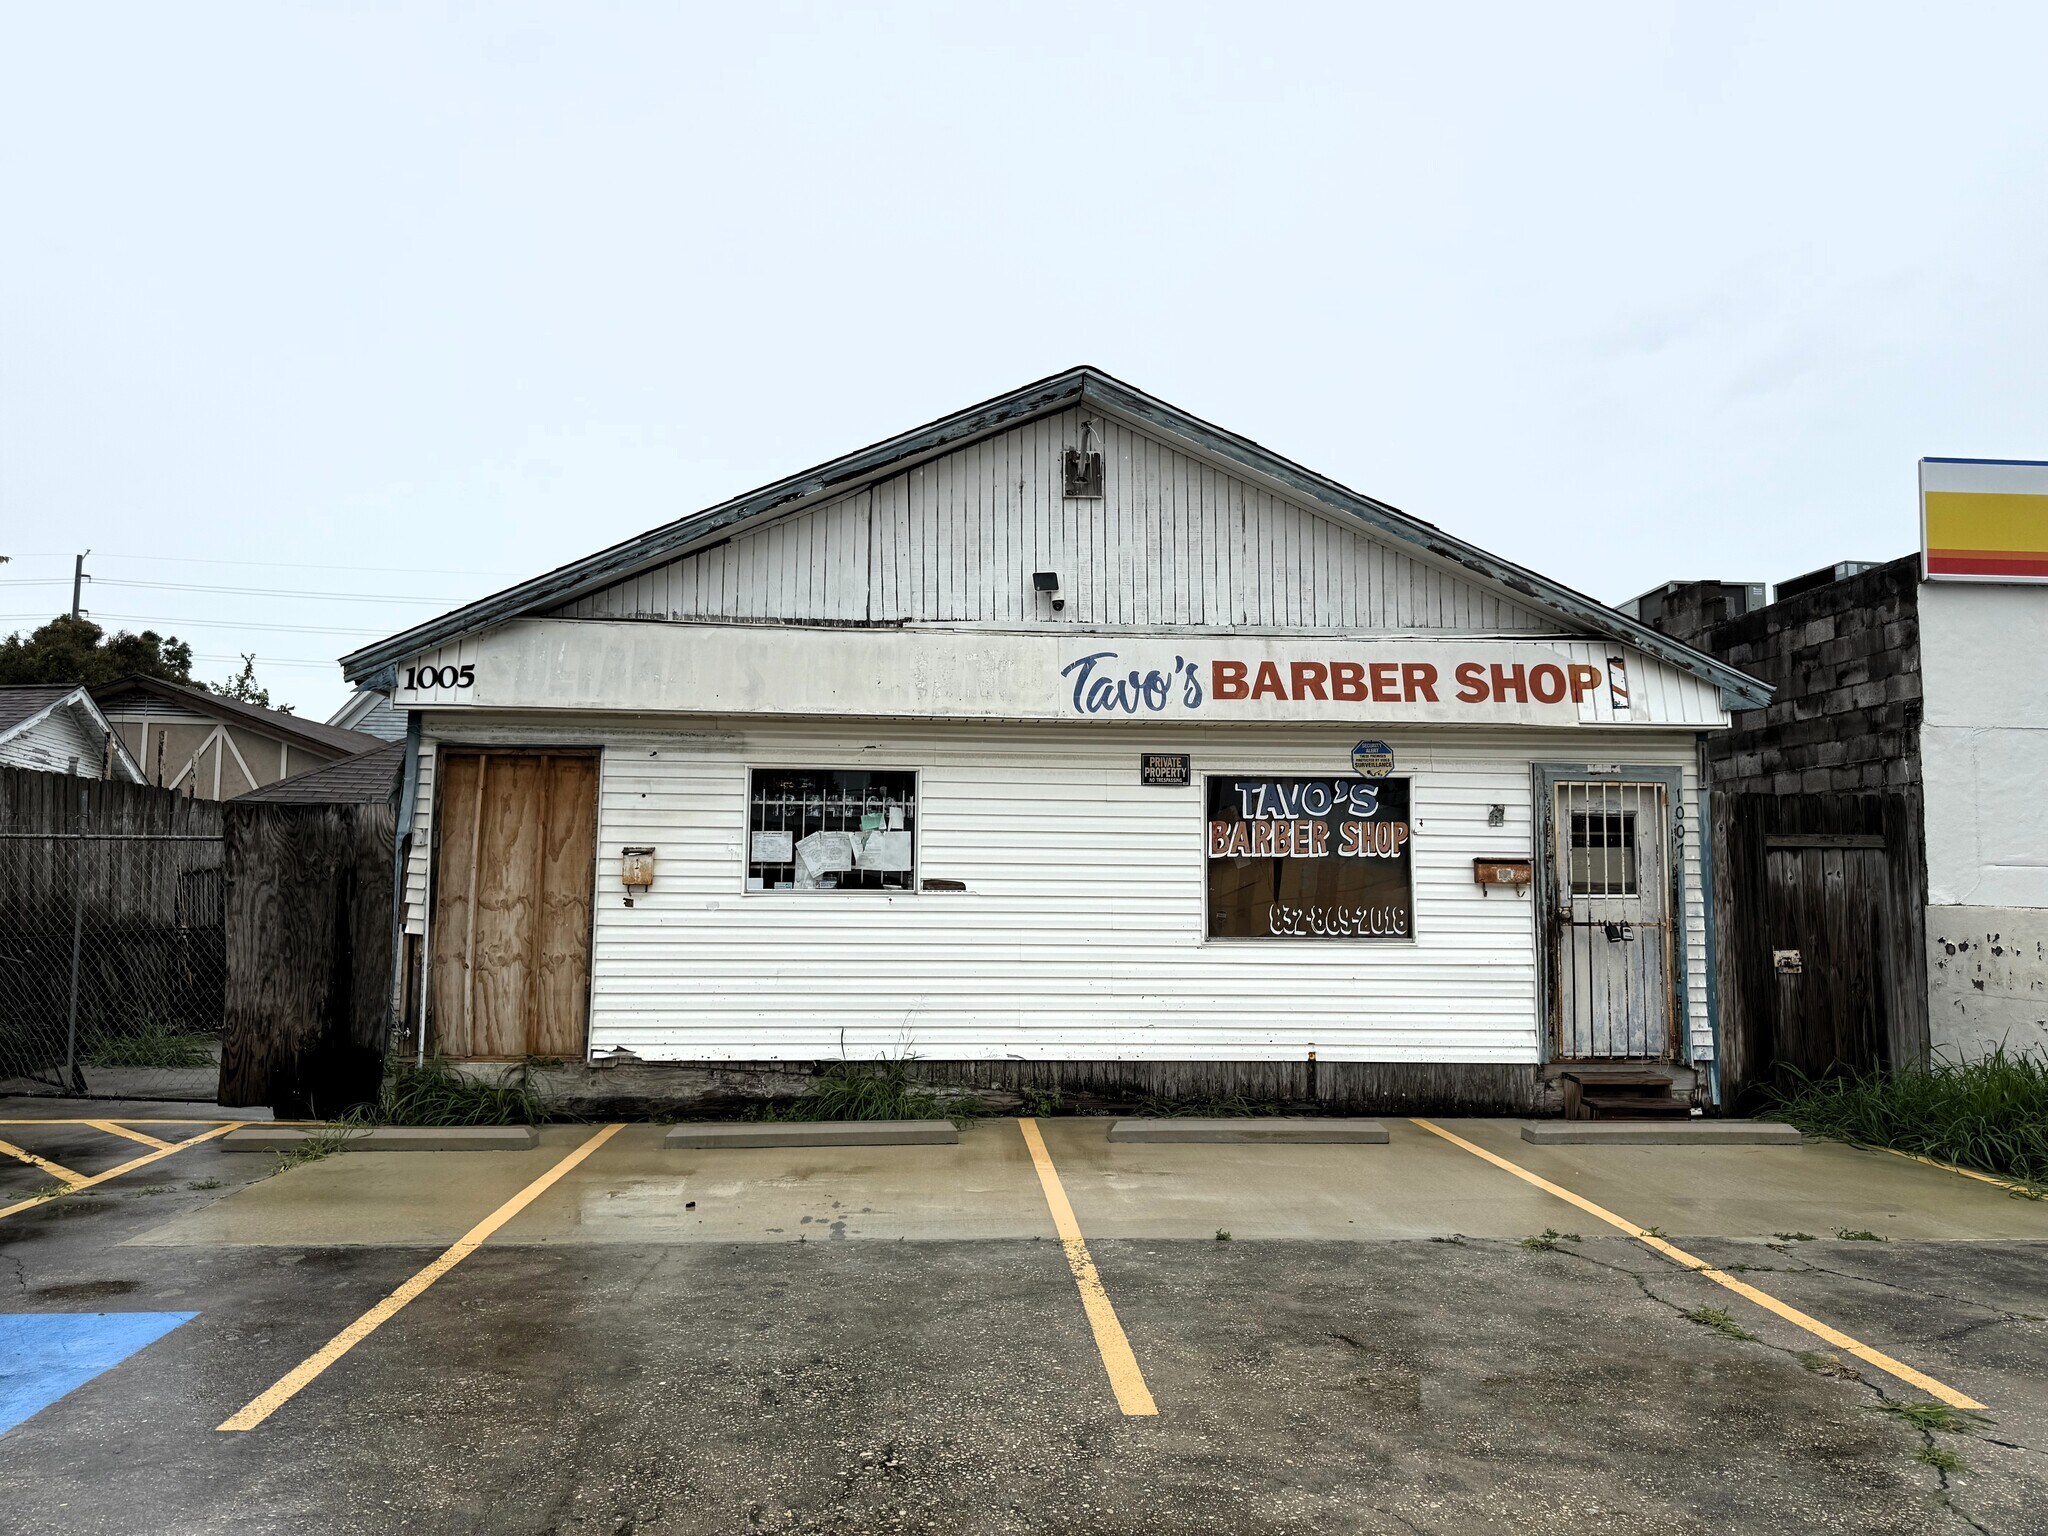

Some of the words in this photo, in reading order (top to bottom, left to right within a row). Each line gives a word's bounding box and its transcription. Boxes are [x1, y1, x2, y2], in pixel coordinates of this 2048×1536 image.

[403, 663, 476, 690] 1005
[1060, 652, 1203, 715] Tavo's
[1212, 660, 1439, 703] BARBER
[1454, 662, 1603, 705] SHOP
[1144, 767, 1187, 778] PROPERTY
[1149, 756, 1182, 768] PRIVATE
[1235, 780, 1379, 819] TAVO'S
[1208, 820, 1330, 858] BARBER
[1338, 821, 1409, 858] SHOP
[1675, 788, 1685, 859] 1007
